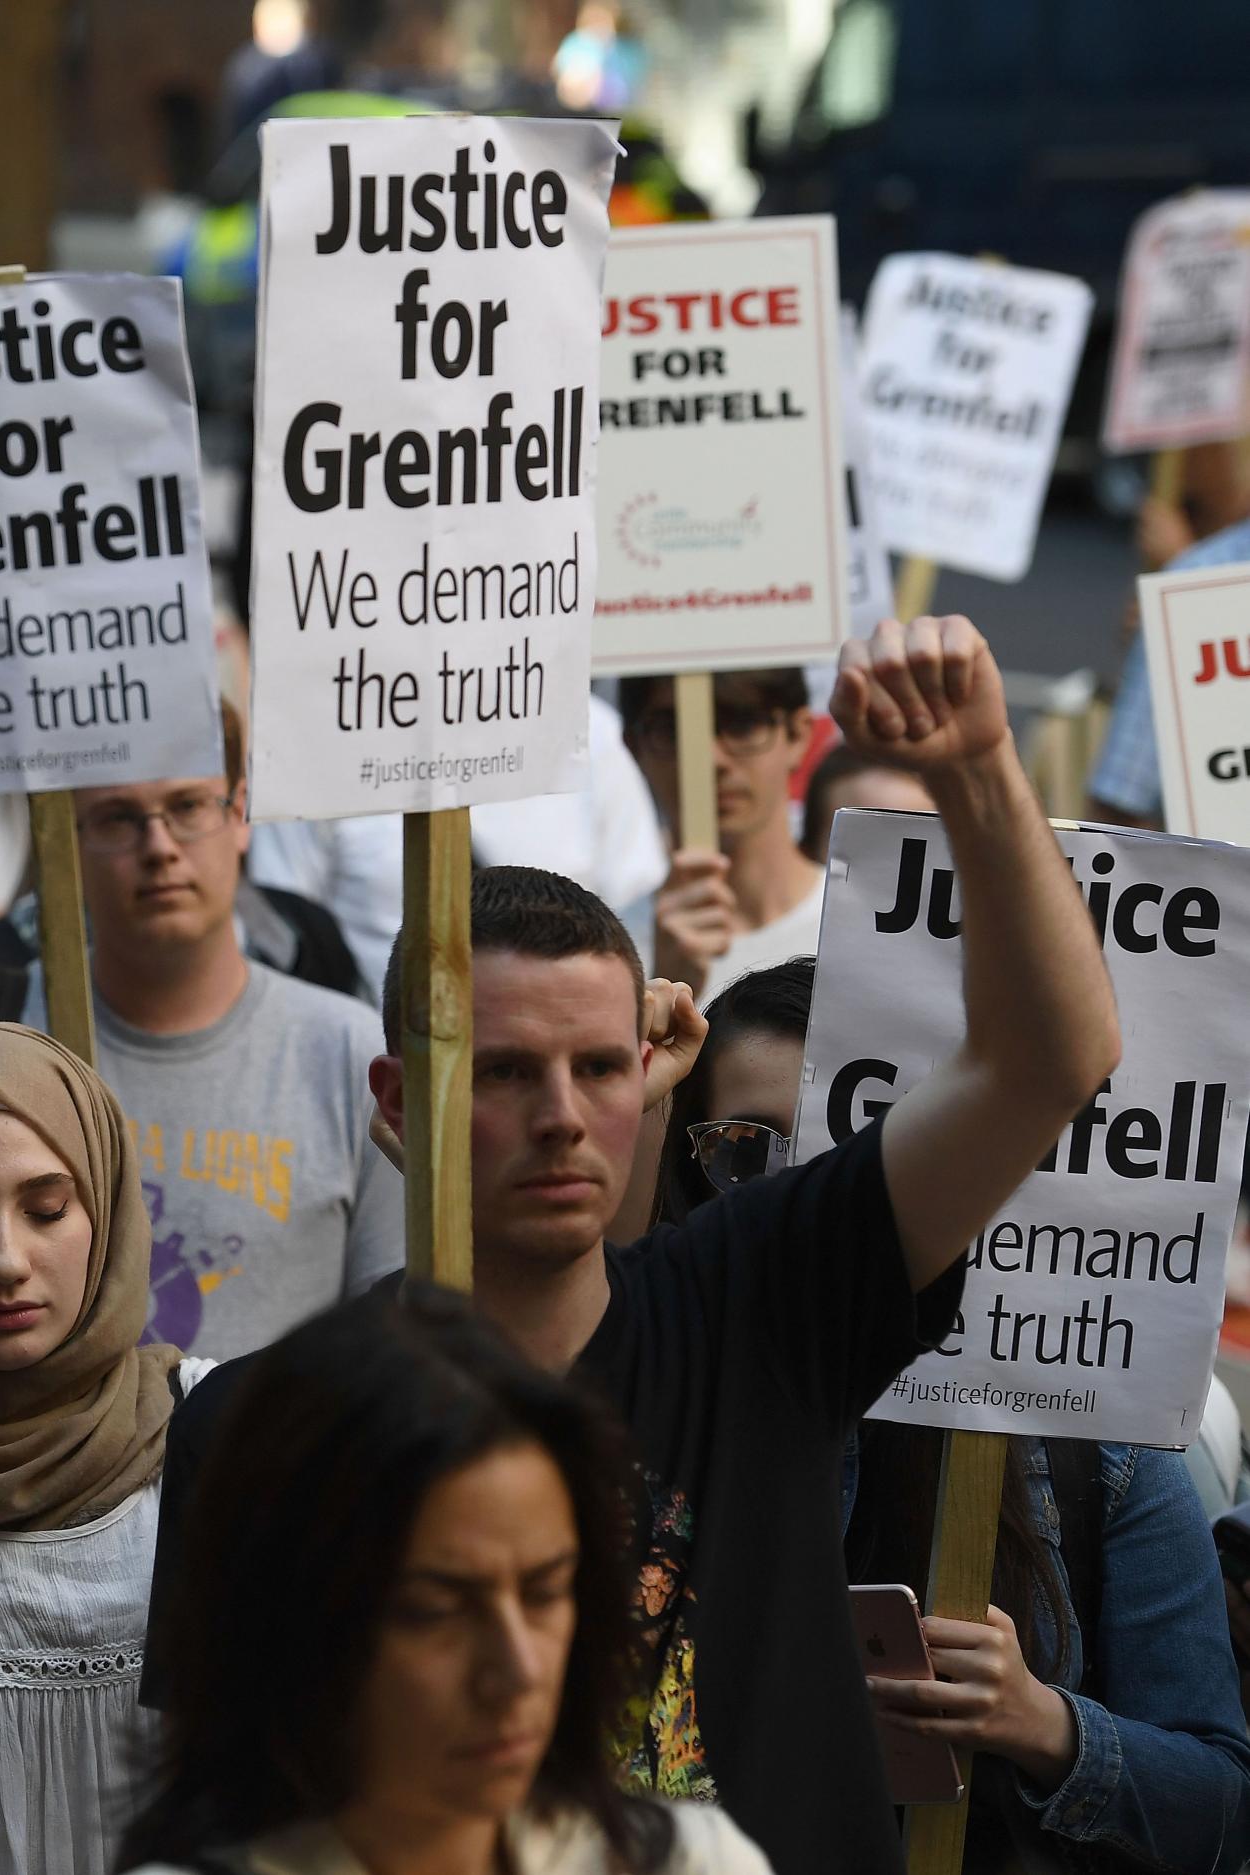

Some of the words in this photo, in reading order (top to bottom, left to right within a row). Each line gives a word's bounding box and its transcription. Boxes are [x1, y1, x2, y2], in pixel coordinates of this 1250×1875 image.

[315, 139, 568, 255] Justice
[395, 268, 508, 380] for
[601, 286, 801, 338] STICE
[599, 389, 805, 431] RENFELL
[633, 347, 726, 382] FOR
[283, 387, 584, 513] Grenfell
[288, 548, 378, 631] We
[399, 532, 579, 626] demand
[28, 662, 150, 732] truth
[332, 647, 419, 732] the
[437, 637, 545, 725] truth
[359, 747, 524, 786] #justiceforgrenfell
[875, 838, 1221, 958] Juice
[826, 1059, 1227, 1183] Gfell
[181, 1128, 294, 1225] LIONS
[987, 1294, 1135, 1370] truth
[892, 1374, 1096, 1413] #justiceforgrenfell
